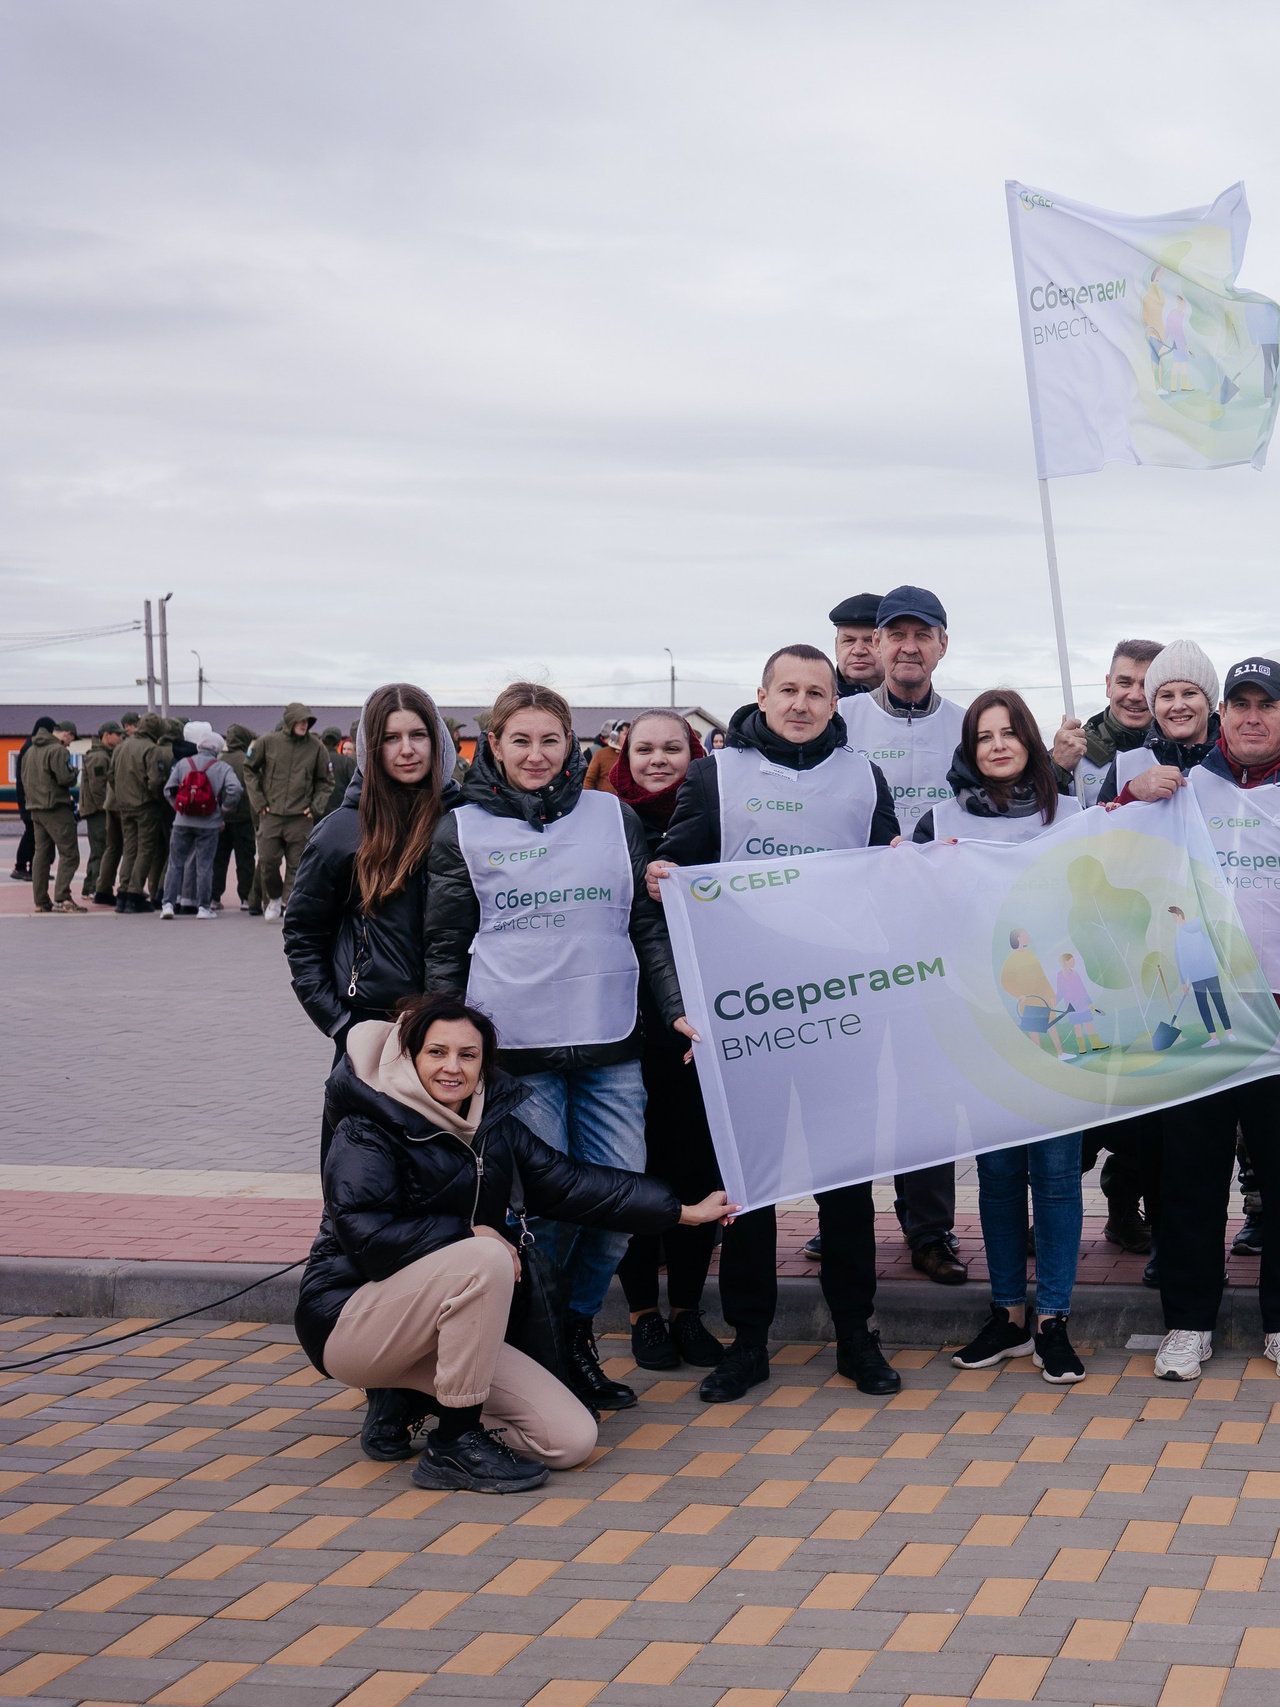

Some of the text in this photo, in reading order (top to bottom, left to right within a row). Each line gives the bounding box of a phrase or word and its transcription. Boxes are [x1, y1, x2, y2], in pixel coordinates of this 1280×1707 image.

[872, 750, 906, 760] СБЕР
[766, 800, 803, 812] СБЕР
[1227, 818, 1261, 828] СБЕР
[509, 847, 547, 862] СБЕР
[729, 868, 800, 892] СБЕР
[495, 886, 611, 910] Сберегаем
[714, 957, 946, 1021] Сберегаем
[721, 1013, 862, 1061] вместе
